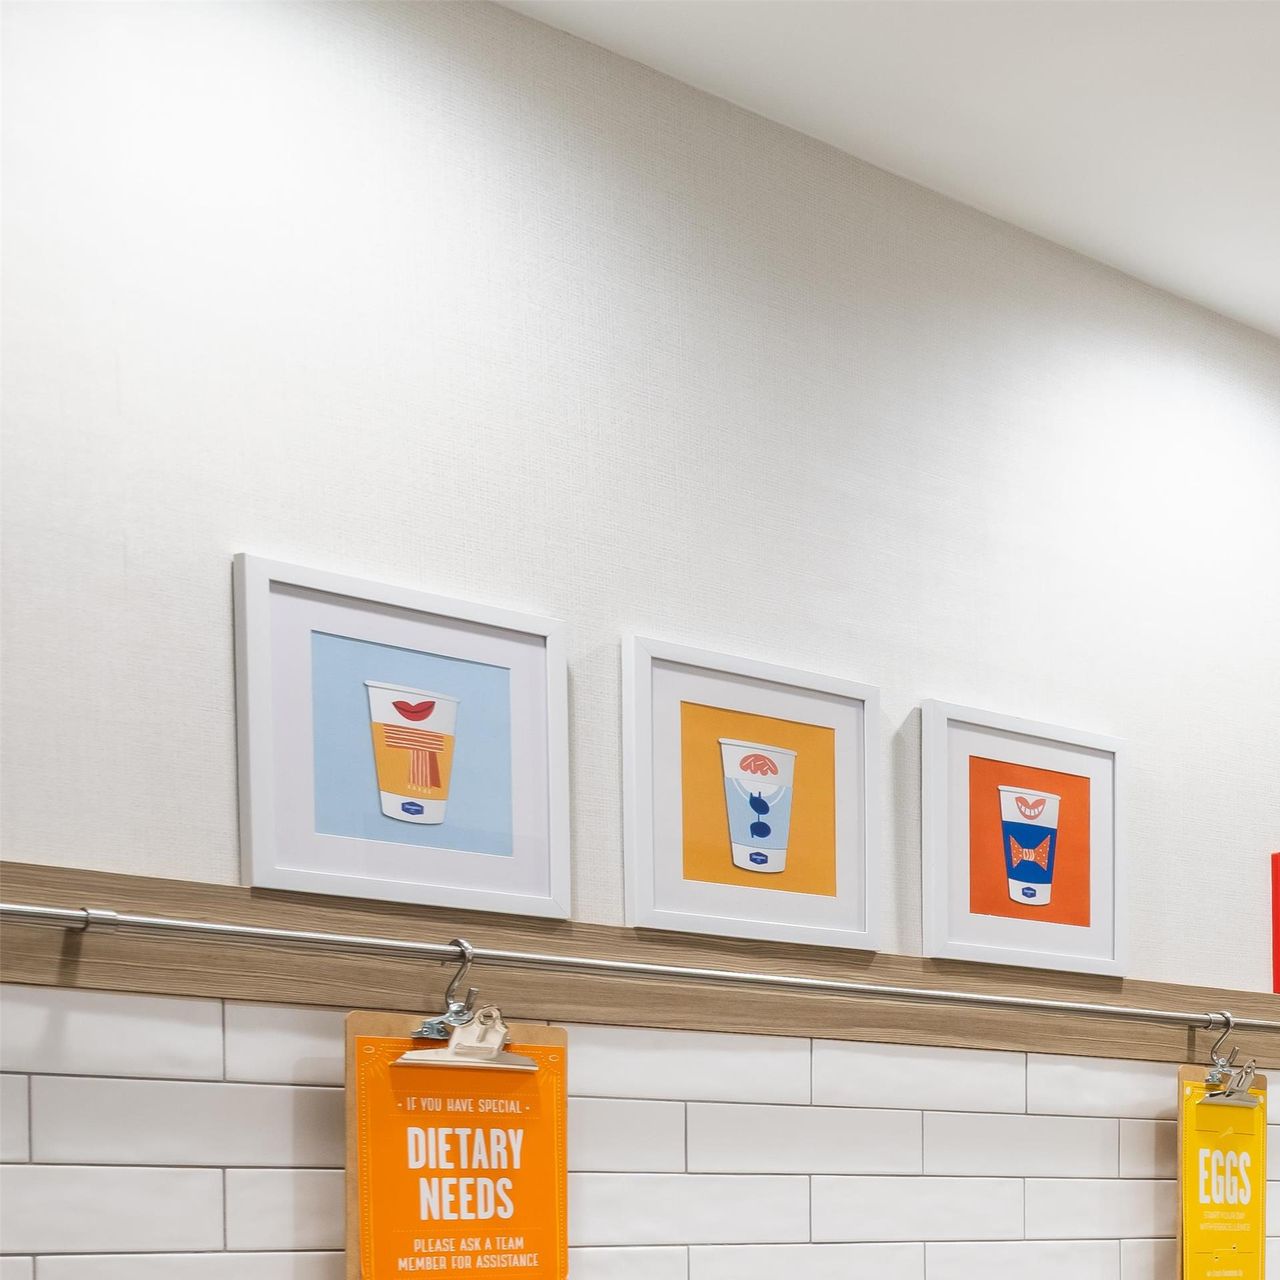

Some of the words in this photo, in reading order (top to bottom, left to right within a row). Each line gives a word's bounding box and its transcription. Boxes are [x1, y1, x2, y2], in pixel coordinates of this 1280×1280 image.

[407, 1097, 417, 1111] IF
[420, 1097, 442, 1112] YOU
[447, 1098, 474, 1113] HAVE
[478, 1099, 523, 1114] SPECIAL
[407, 1126, 524, 1169] DIETARY
[1199, 1148, 1251, 1205] EGGS
[419, 1177, 514, 1220] NEEDS
[413, 1237, 456, 1252] PLEASE
[459, 1237, 481, 1251] ASK
[484, 1237, 493, 1251] A
[495, 1236, 524, 1250] TEAM
[397, 1256, 447, 1272] MEMBER
[451, 1255, 472, 1270] FOR
[476, 1253, 540, 1269] ASSISTANCE
